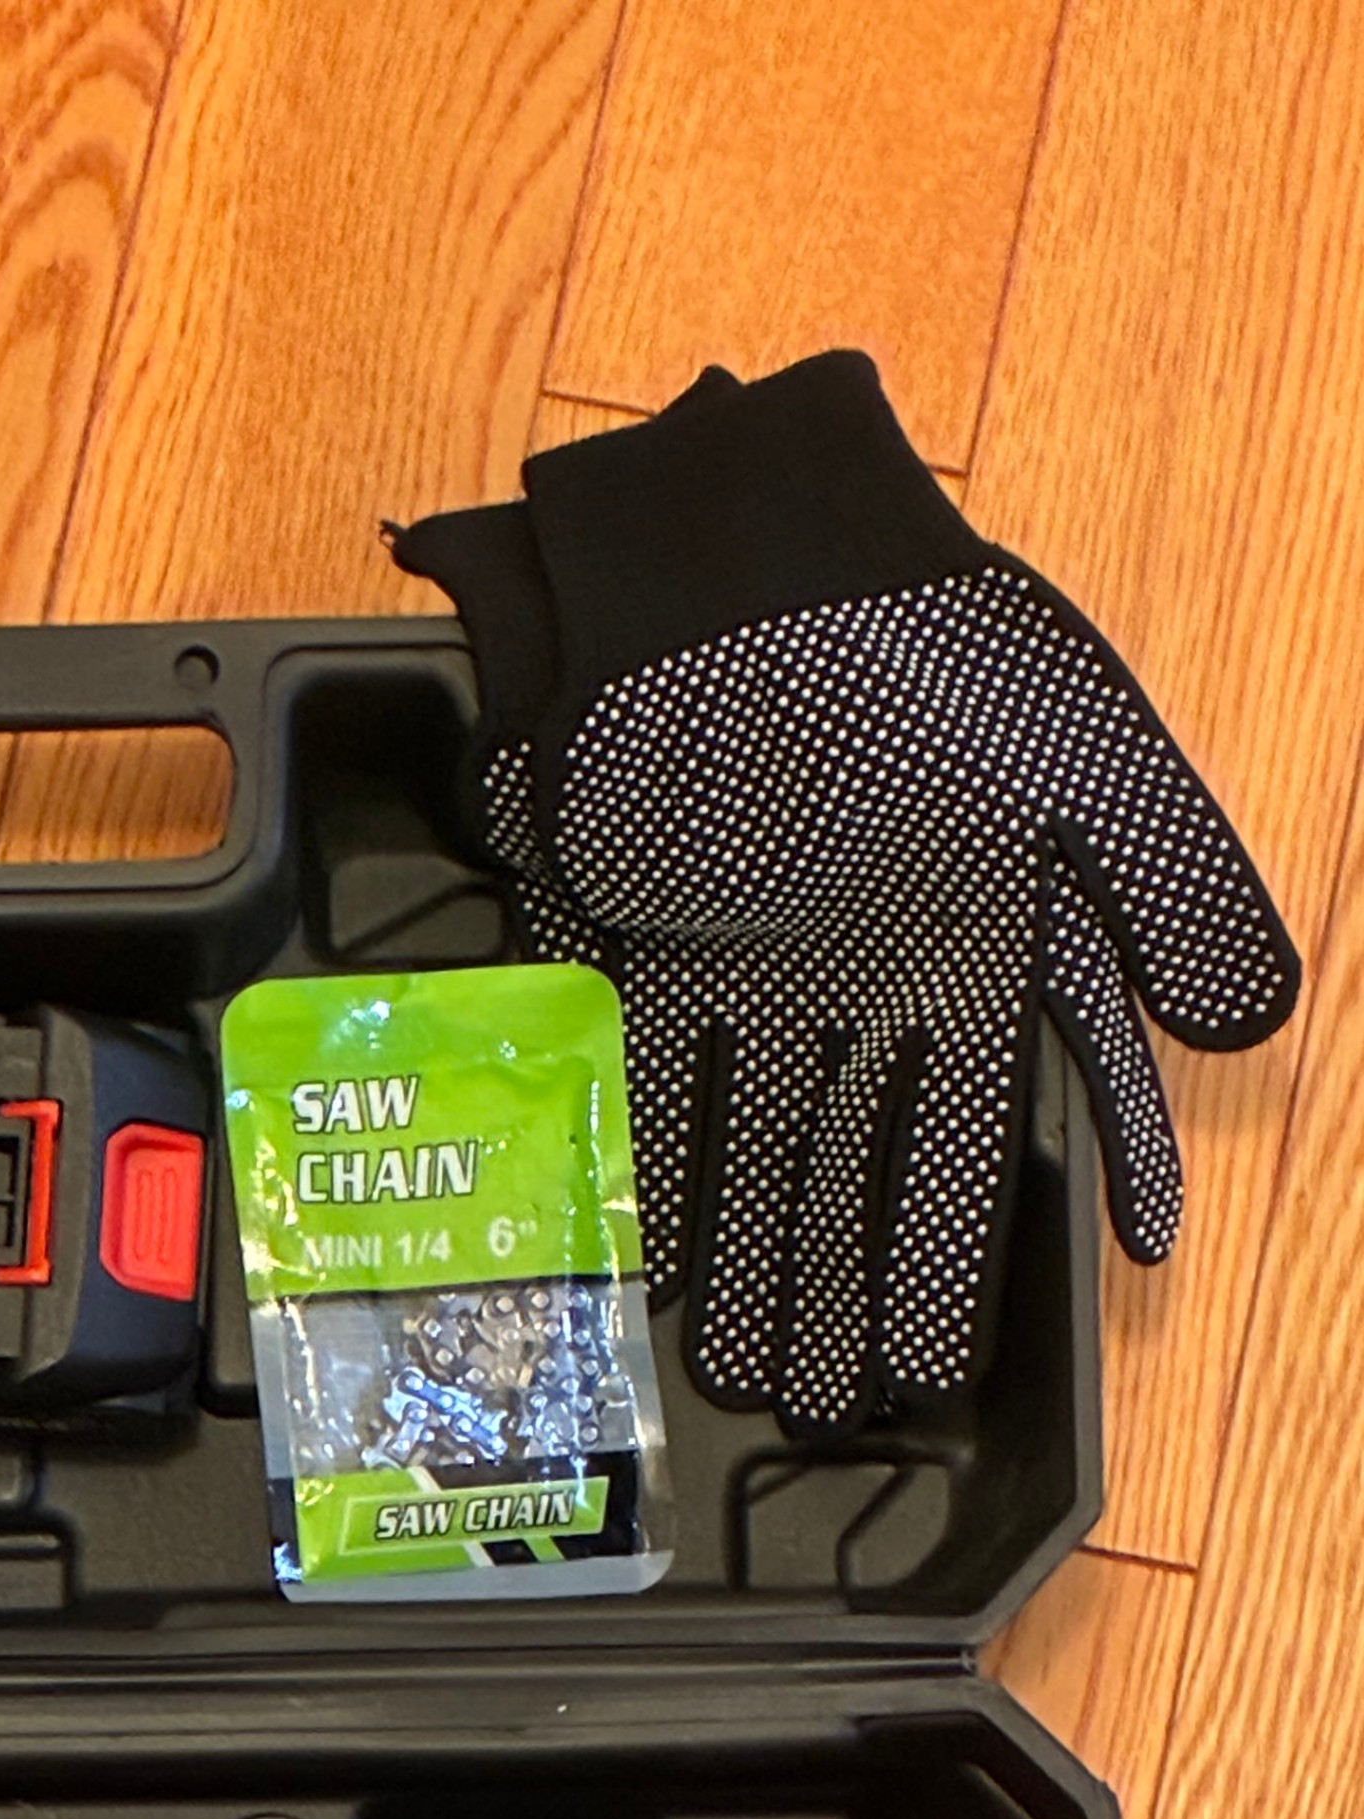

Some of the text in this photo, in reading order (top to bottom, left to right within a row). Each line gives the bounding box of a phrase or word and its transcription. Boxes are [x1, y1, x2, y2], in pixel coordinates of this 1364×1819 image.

[292, 1075, 419, 1134] SAW
[297, 1140, 478, 1204] CHAIN
[303, 1234, 382, 1268] MINI
[396, 1229, 451, 1263] 1/4
[375, 1490, 573, 1541] SAW CHAIN
